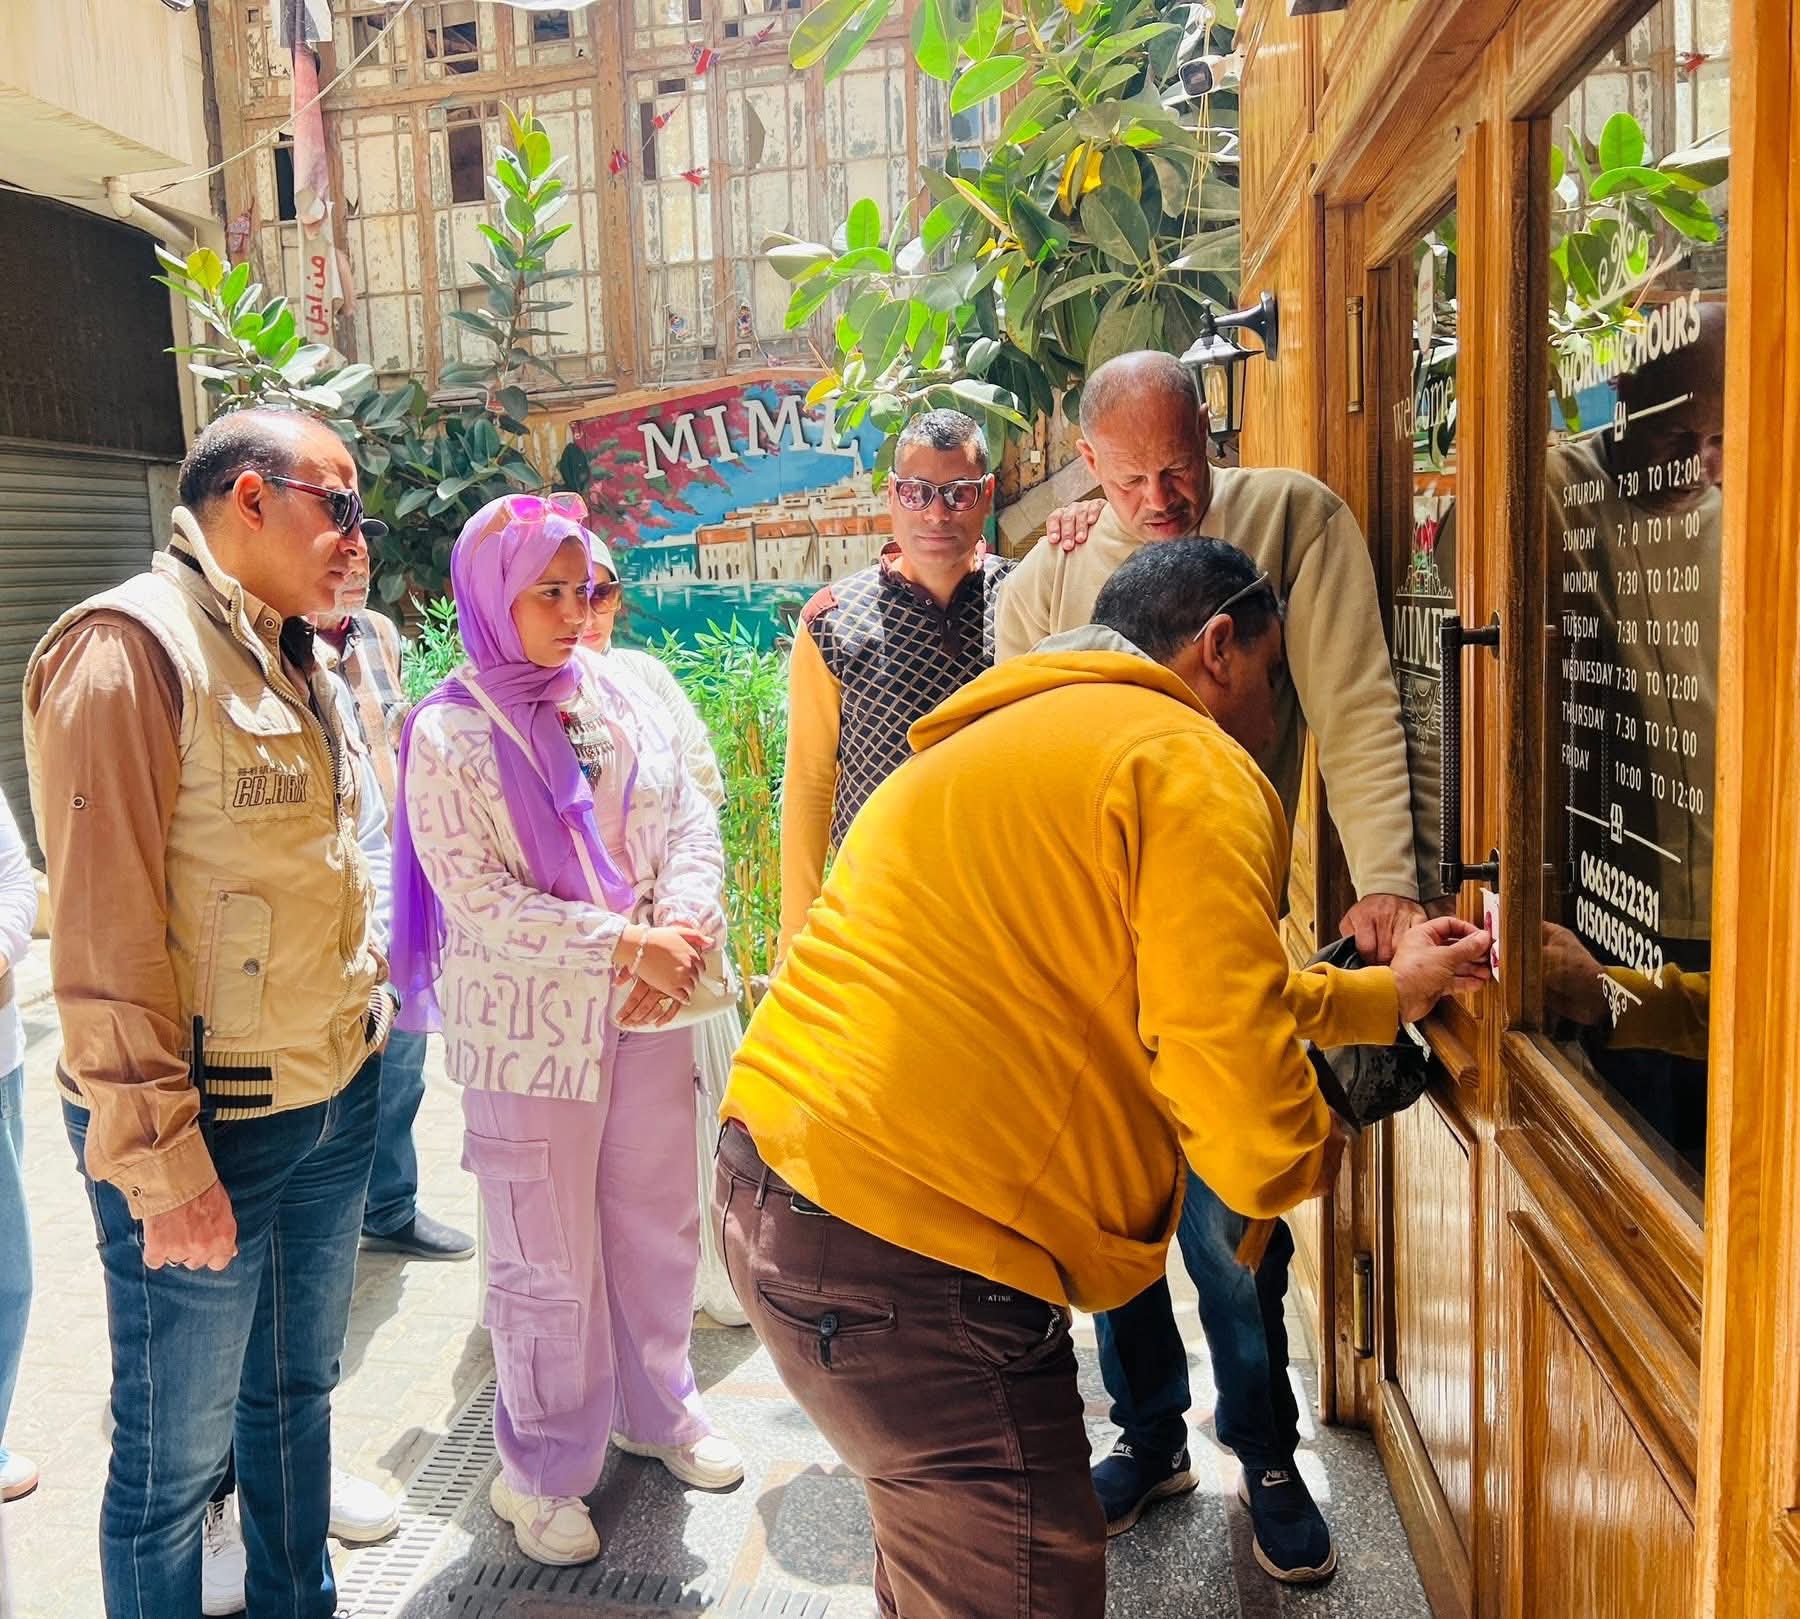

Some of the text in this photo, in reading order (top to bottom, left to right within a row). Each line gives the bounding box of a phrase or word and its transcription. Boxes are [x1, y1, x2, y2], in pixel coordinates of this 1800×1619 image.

[306, 254, 327, 289] من
[1634, 287, 1701, 368] HOURS
[1392, 369, 1454, 443] welcome
[1563, 480, 1605, 508] SATURDAY
[1647, 464, 1663, 492] TO
[1667, 454, 1701, 487] 12:00
[1563, 527, 1596, 551] SUNDAY
[1647, 517, 1662, 544] TO
[1562, 564, 1700, 595] MONDAY 7:30 TO 12:00
[1393, 604, 1457, 671] MIME
[1562, 616, 1600, 640] TUESDAY
[1616, 620, 1638, 644] 7:30
[1646, 619, 1661, 646] TO
[1561, 658, 1698, 702] WEDNESDAY 7:30 TO 12:00
[1562, 700, 1605, 731] THURSDAY
[1645, 720, 1660, 748] TO
[1561, 744, 1704, 815] FRIDAY 10:00 TO 12:00
[1580, 850, 1660, 933] 0663232331
[1576, 895, 1664, 990] 01500503232
